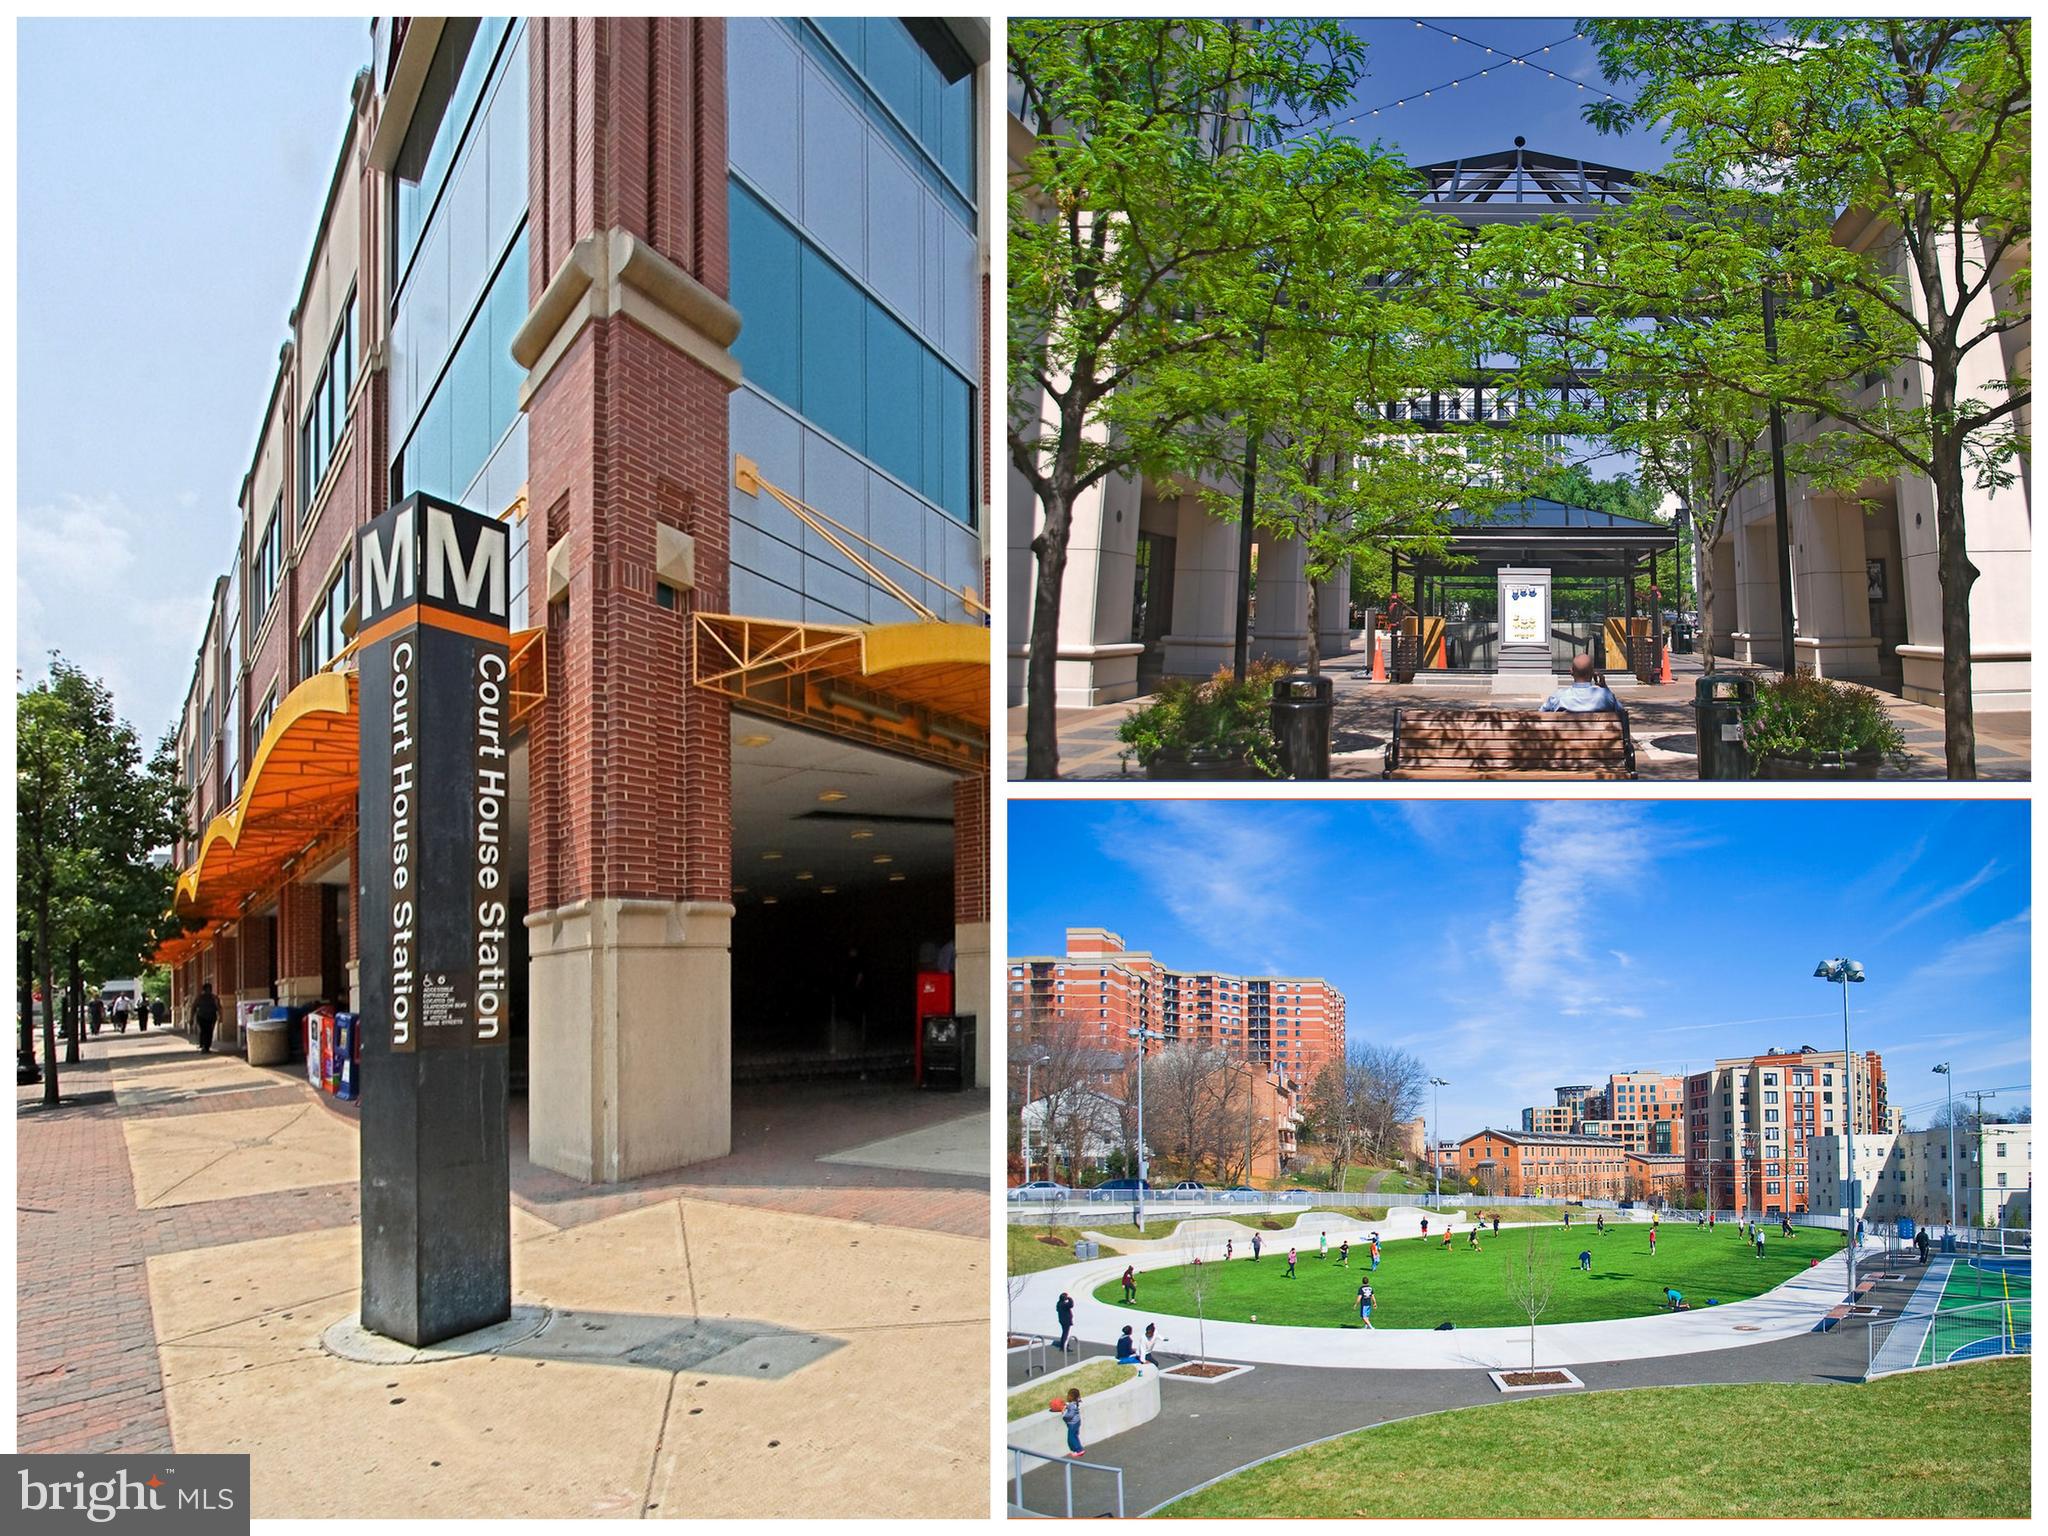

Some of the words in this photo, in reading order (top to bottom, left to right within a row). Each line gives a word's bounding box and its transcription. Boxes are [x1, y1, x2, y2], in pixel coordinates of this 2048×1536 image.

[361, 505, 414, 621] M
[426, 505, 506, 617] M
[393, 642, 413, 755] Court
[478, 653, 507, 759] Court
[393, 762, 413, 890] House
[478, 768, 506, 890] House
[393, 900, 413, 1044] Station
[478, 900, 506, 1039] Station
